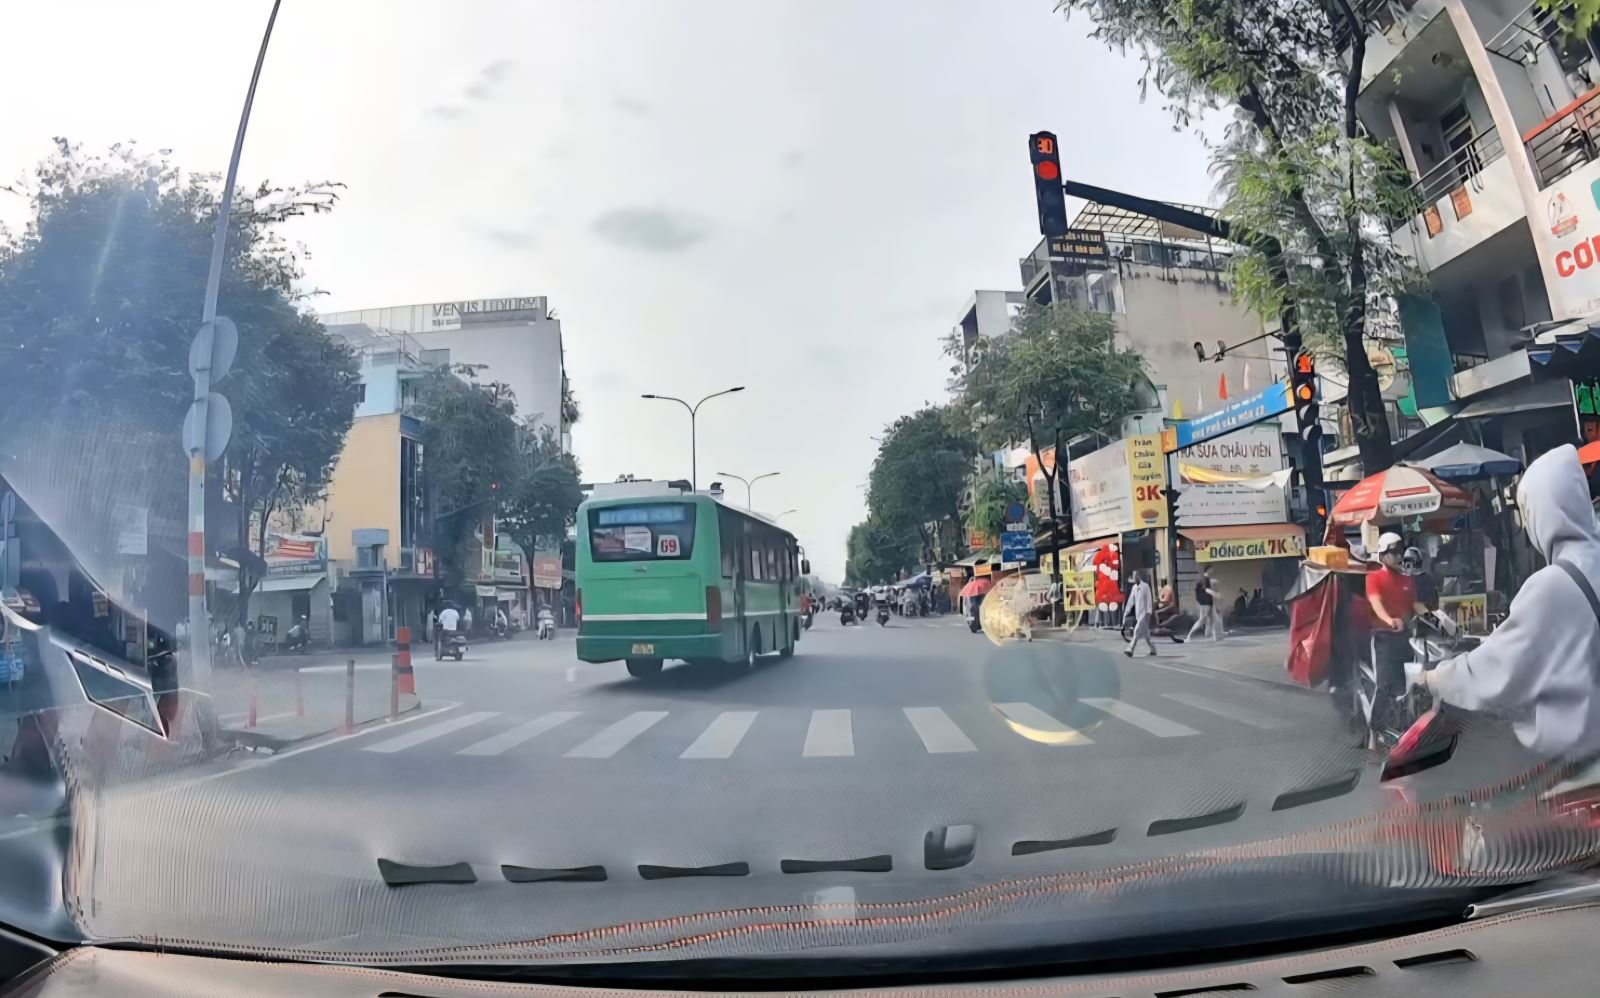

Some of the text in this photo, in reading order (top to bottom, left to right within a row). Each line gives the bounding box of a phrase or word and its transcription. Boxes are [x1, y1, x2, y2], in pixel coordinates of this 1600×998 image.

[1037, 137, 1053, 154] 30
[1136, 484, 1161, 501] 3K
[661, 539, 677, 553] 69
[1268, 538, 1287, 554] 7K
